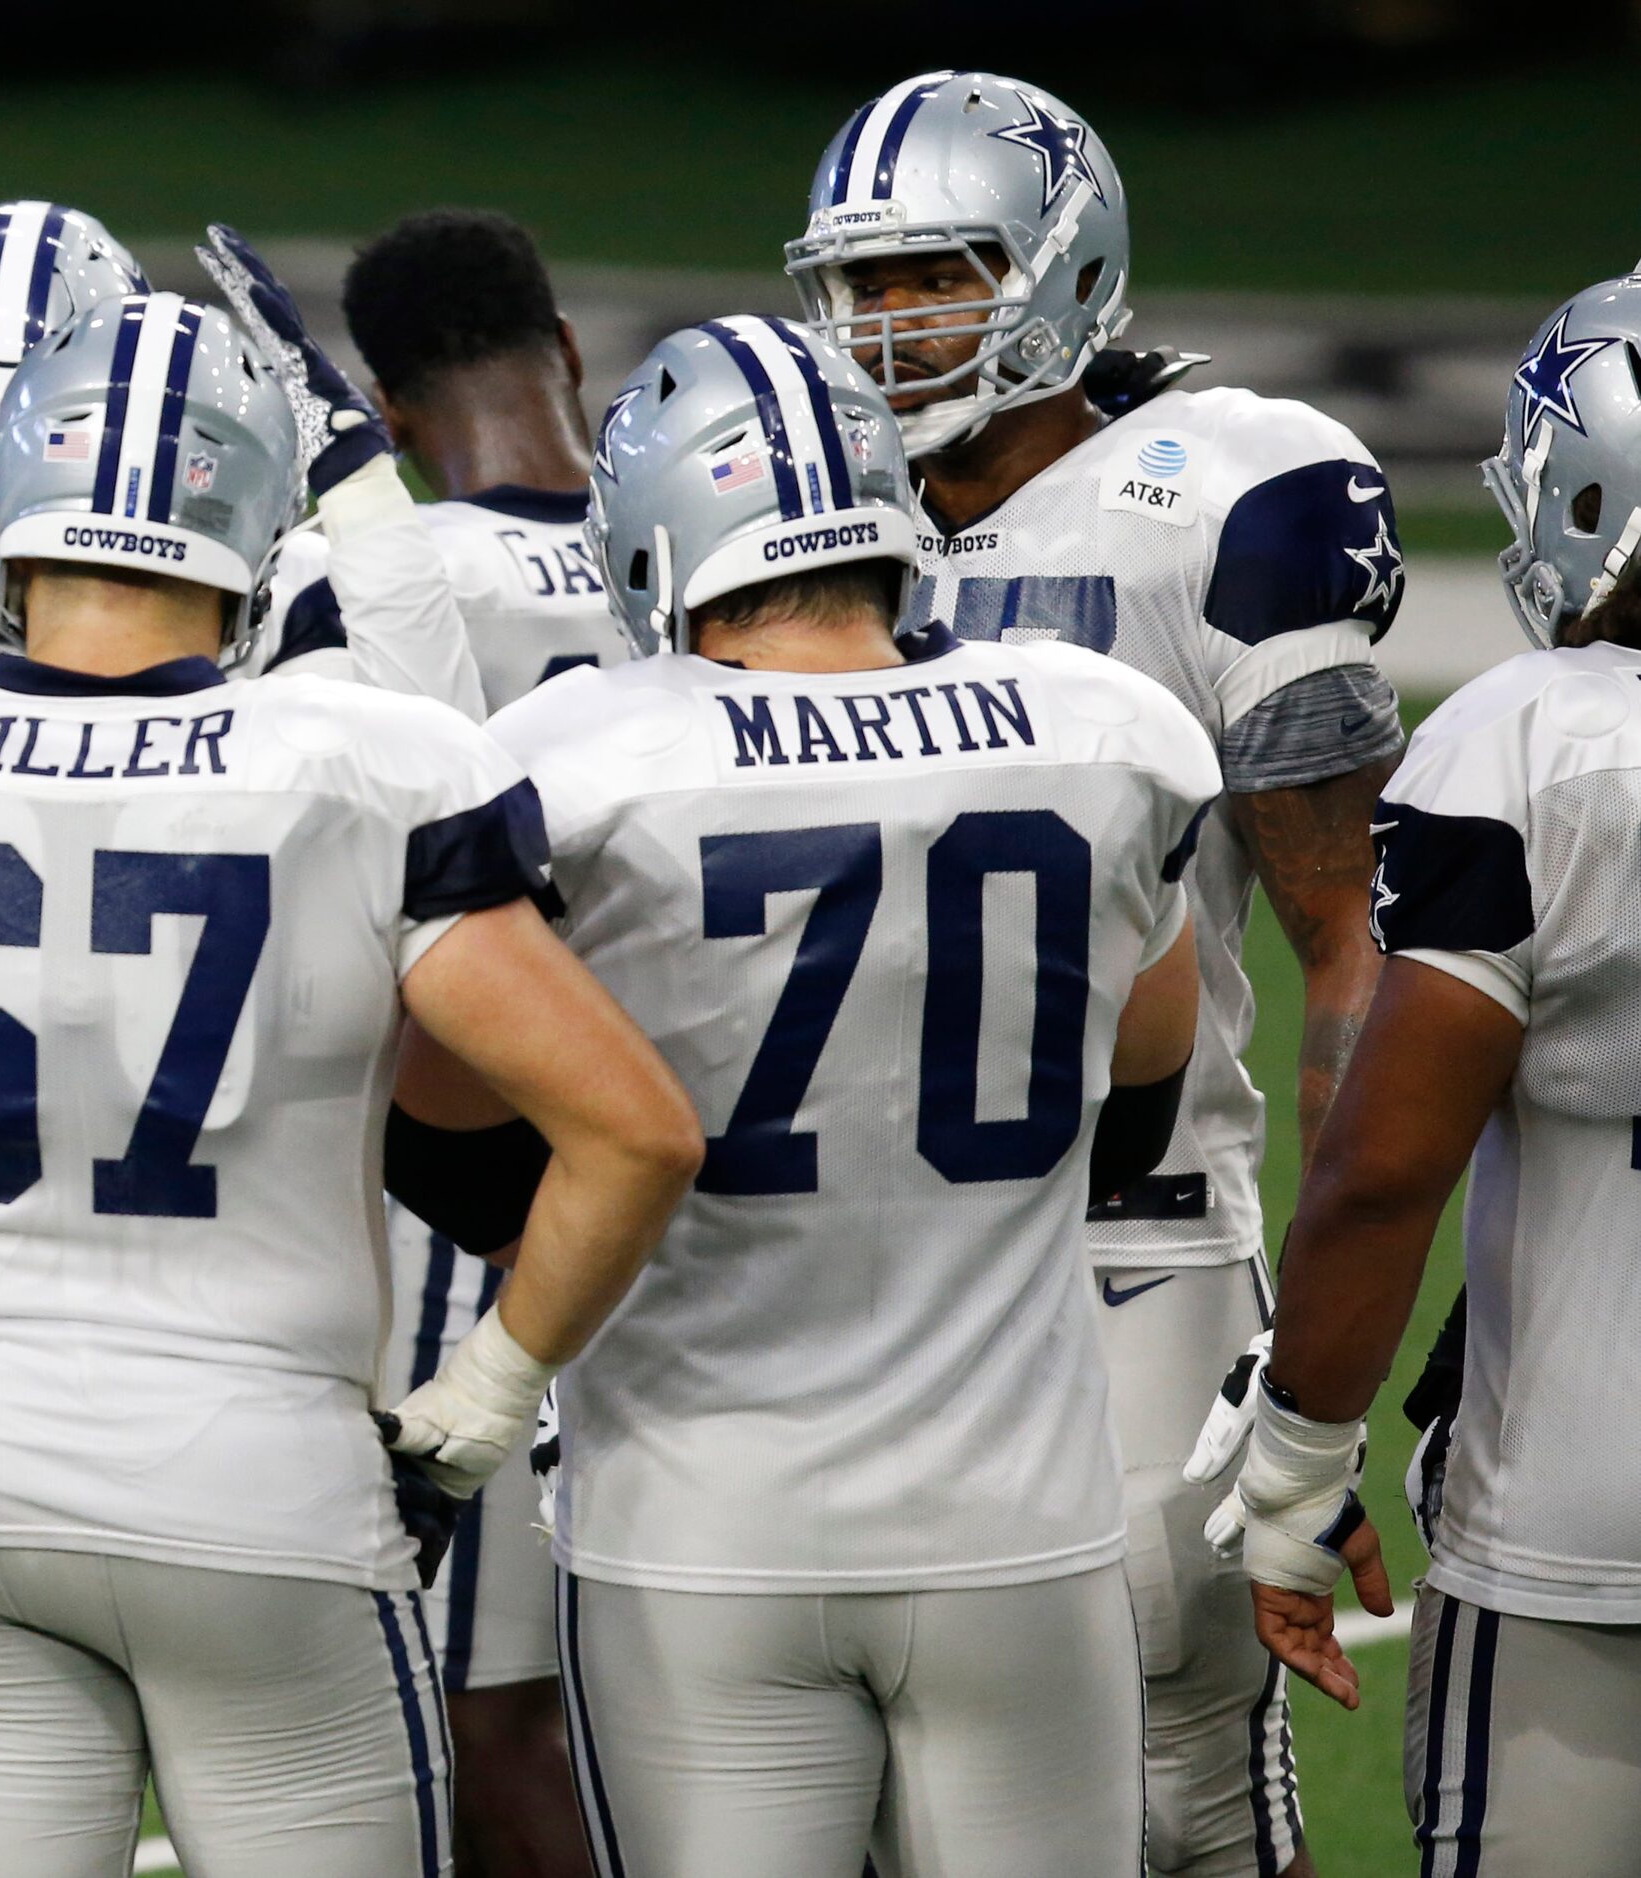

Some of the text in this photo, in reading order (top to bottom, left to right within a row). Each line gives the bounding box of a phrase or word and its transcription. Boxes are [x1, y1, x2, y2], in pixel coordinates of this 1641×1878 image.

[832, 211, 881, 226] COWBOYS
[1119, 480, 1182, 509] AT&T
[64, 526, 187, 562] COWBOYS
[763, 522, 879, 561] COWBOYS
[715, 678, 1037, 768] MARTIN
[695, 809, 1092, 1194] 70
